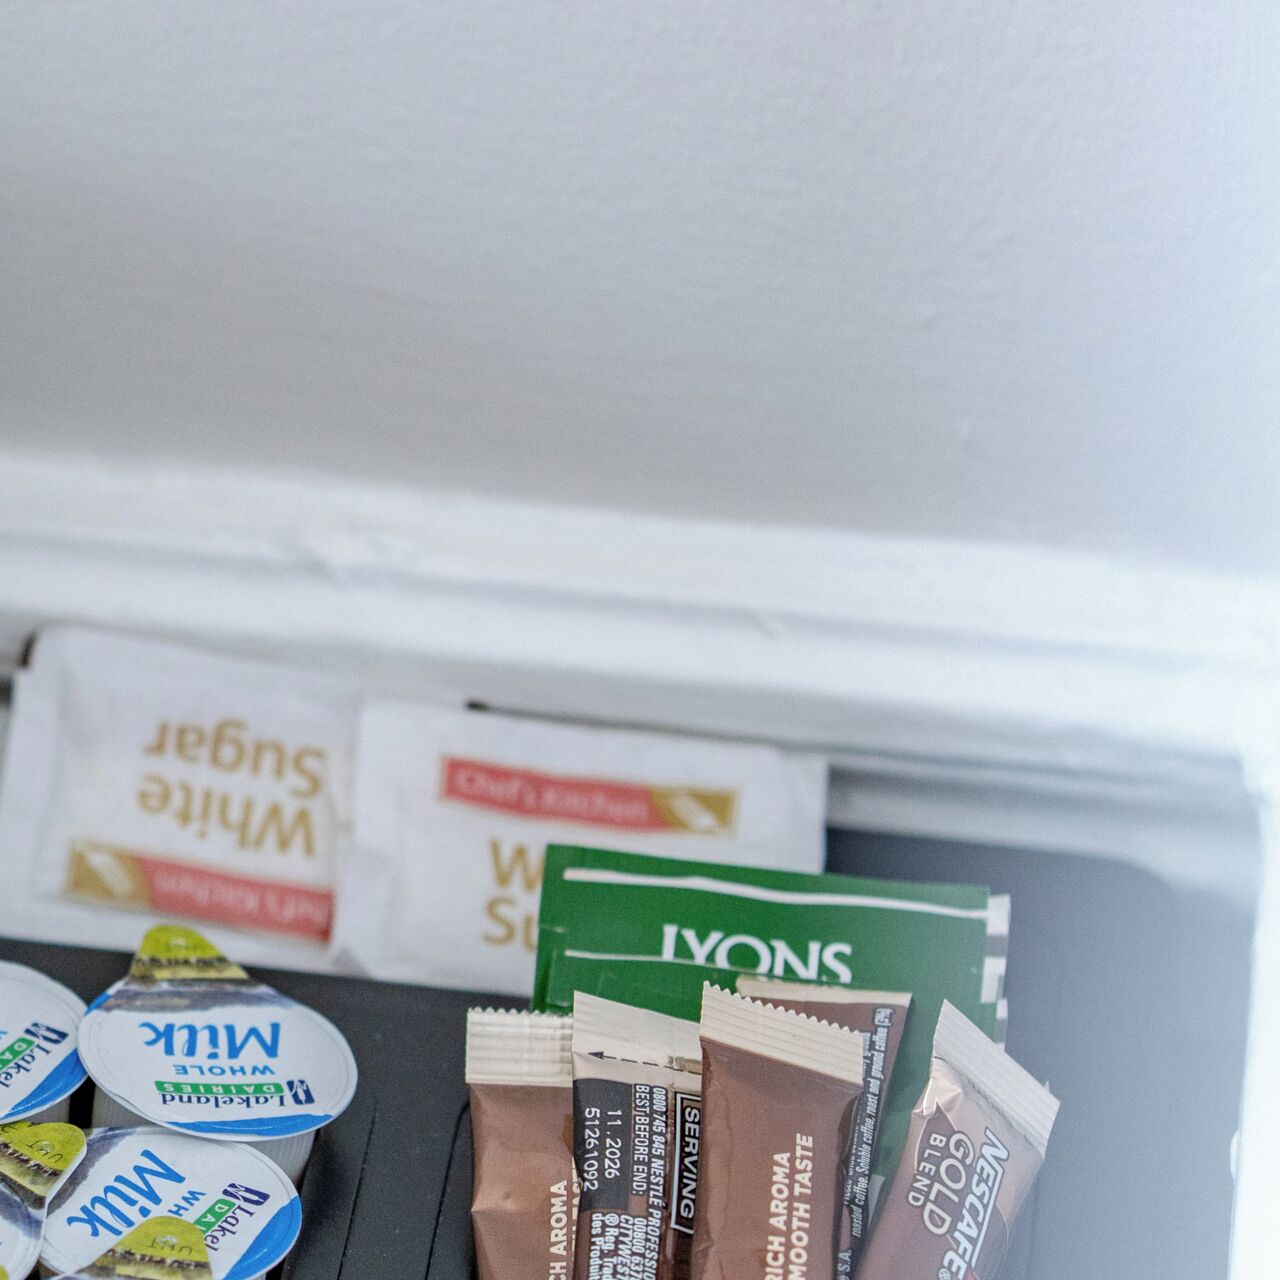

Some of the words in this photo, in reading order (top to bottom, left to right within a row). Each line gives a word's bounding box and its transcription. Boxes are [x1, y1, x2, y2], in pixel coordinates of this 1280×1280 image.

[143, 718, 326, 801] Sugar
[137, 773, 316, 860] White
[138, 1022, 280, 1060] Milk
[174, 1064, 275, 1076] WHOLE
[871, 1050, 886, 1080] ground
[161, 1093, 286, 1108] Lakeland
[163, 1082, 276, 1095] DAIRIES
[635, 1085, 650, 1113] BEST
[652, 1087, 666, 1112] 0800
[868, 1080, 882, 1094] and
[651, 1113, 665, 1133] 745
[865, 1094, 879, 1117] roast
[583, 1107, 600, 1192] 51261092
[605, 1109, 623, 1179] 11.2026
[633, 1116, 649, 1162] BEFORE
[651, 1135, 665, 1156] 845
[680, 1107, 700, 1218] SERVING
[794, 1133, 814, 1197] TASTE
[855, 1145, 873, 1175] Soluble
[907, 1133, 947, 1207] BLEND
[66, 1149, 186, 1238] Milk
[632, 1165, 647, 1195] END:
[649, 1158, 665, 1207] NESTLÉ
[768, 1152, 791, 1231] AROMA
[923, 1132, 975, 1235] GOLD
[549, 1180, 568, 1256] AROMA
[591, 1213, 604, 1234] des
[632, 1217, 647, 1253] 00800
[603, 1227, 619, 1253] Reg.
